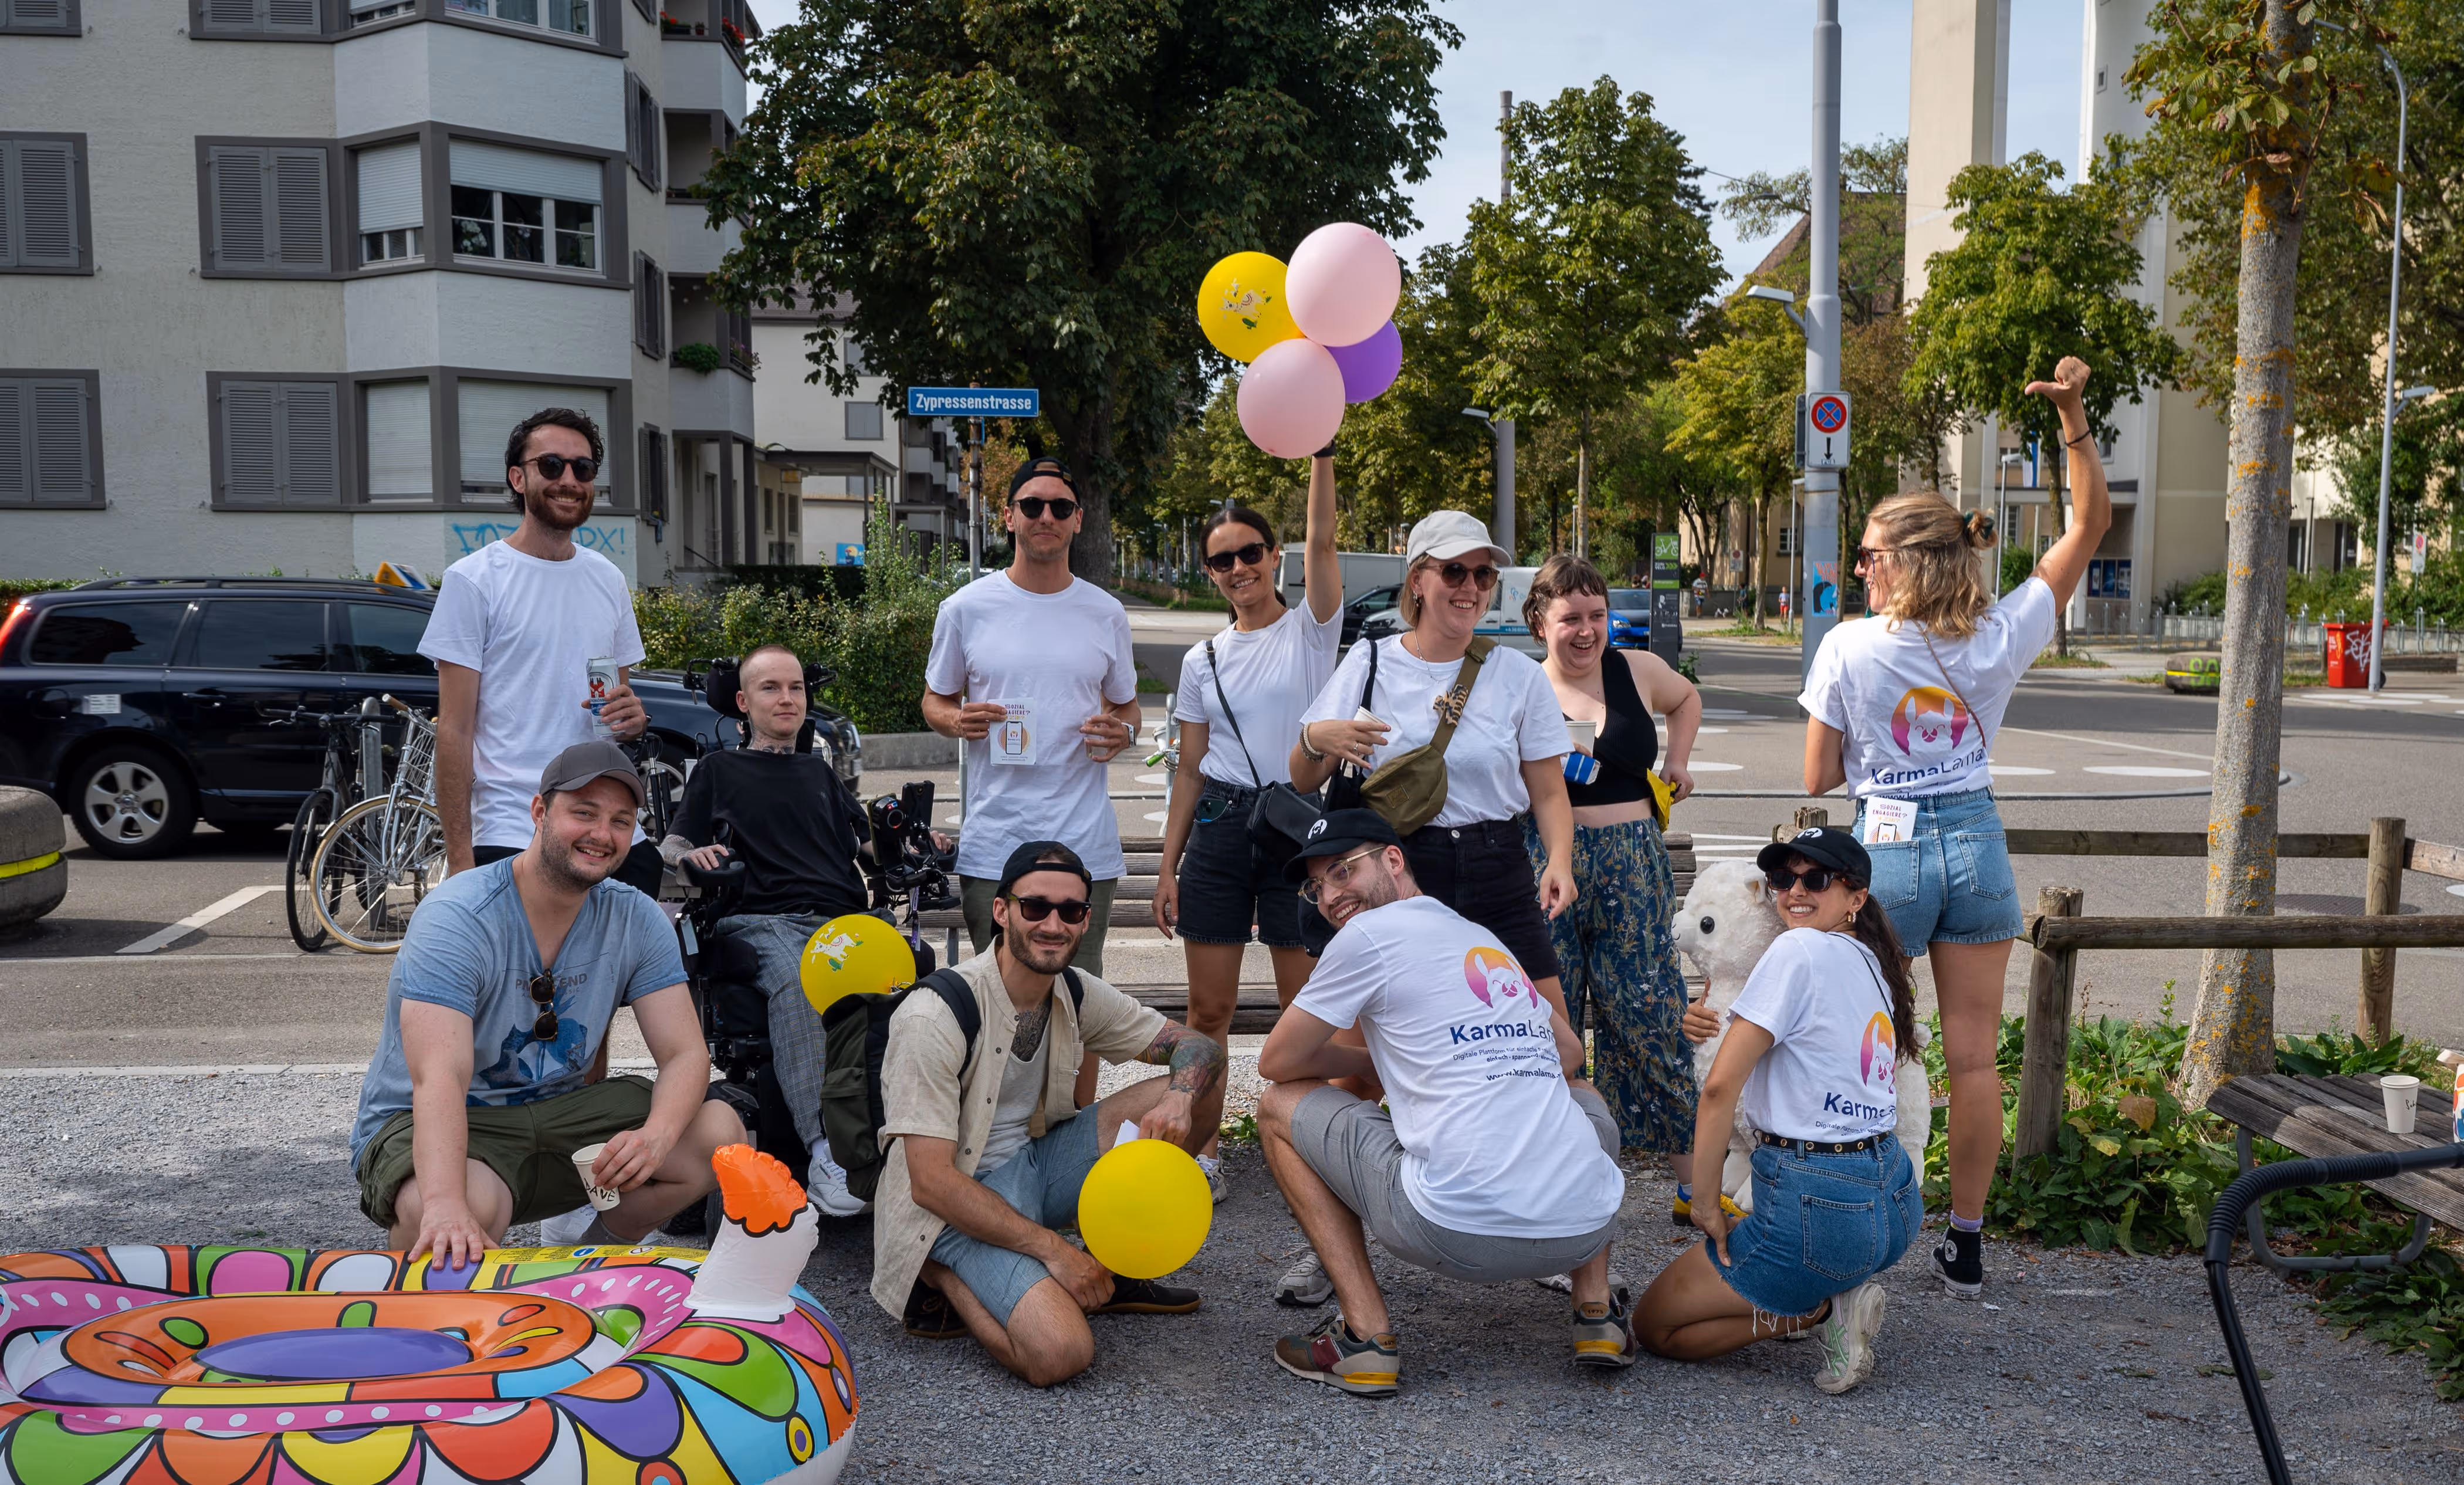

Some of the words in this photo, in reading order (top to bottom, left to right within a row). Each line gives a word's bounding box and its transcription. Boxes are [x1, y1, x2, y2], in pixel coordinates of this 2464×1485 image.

[916, 394, 1031, 411] Zypressenstrasse
[1871, 749, 1983, 784] KarmaLama
[1450, 1020, 1555, 1045] KarmaLa
[1453, 1050, 1477, 1060] Digitale
[1512, 1053, 1539, 1061] spannend
[1487, 1068, 1561, 1081] www.karmalama.
[1815, 1121, 1840, 1130] Digitale
[584, 1178, 615, 1202] DAVE
